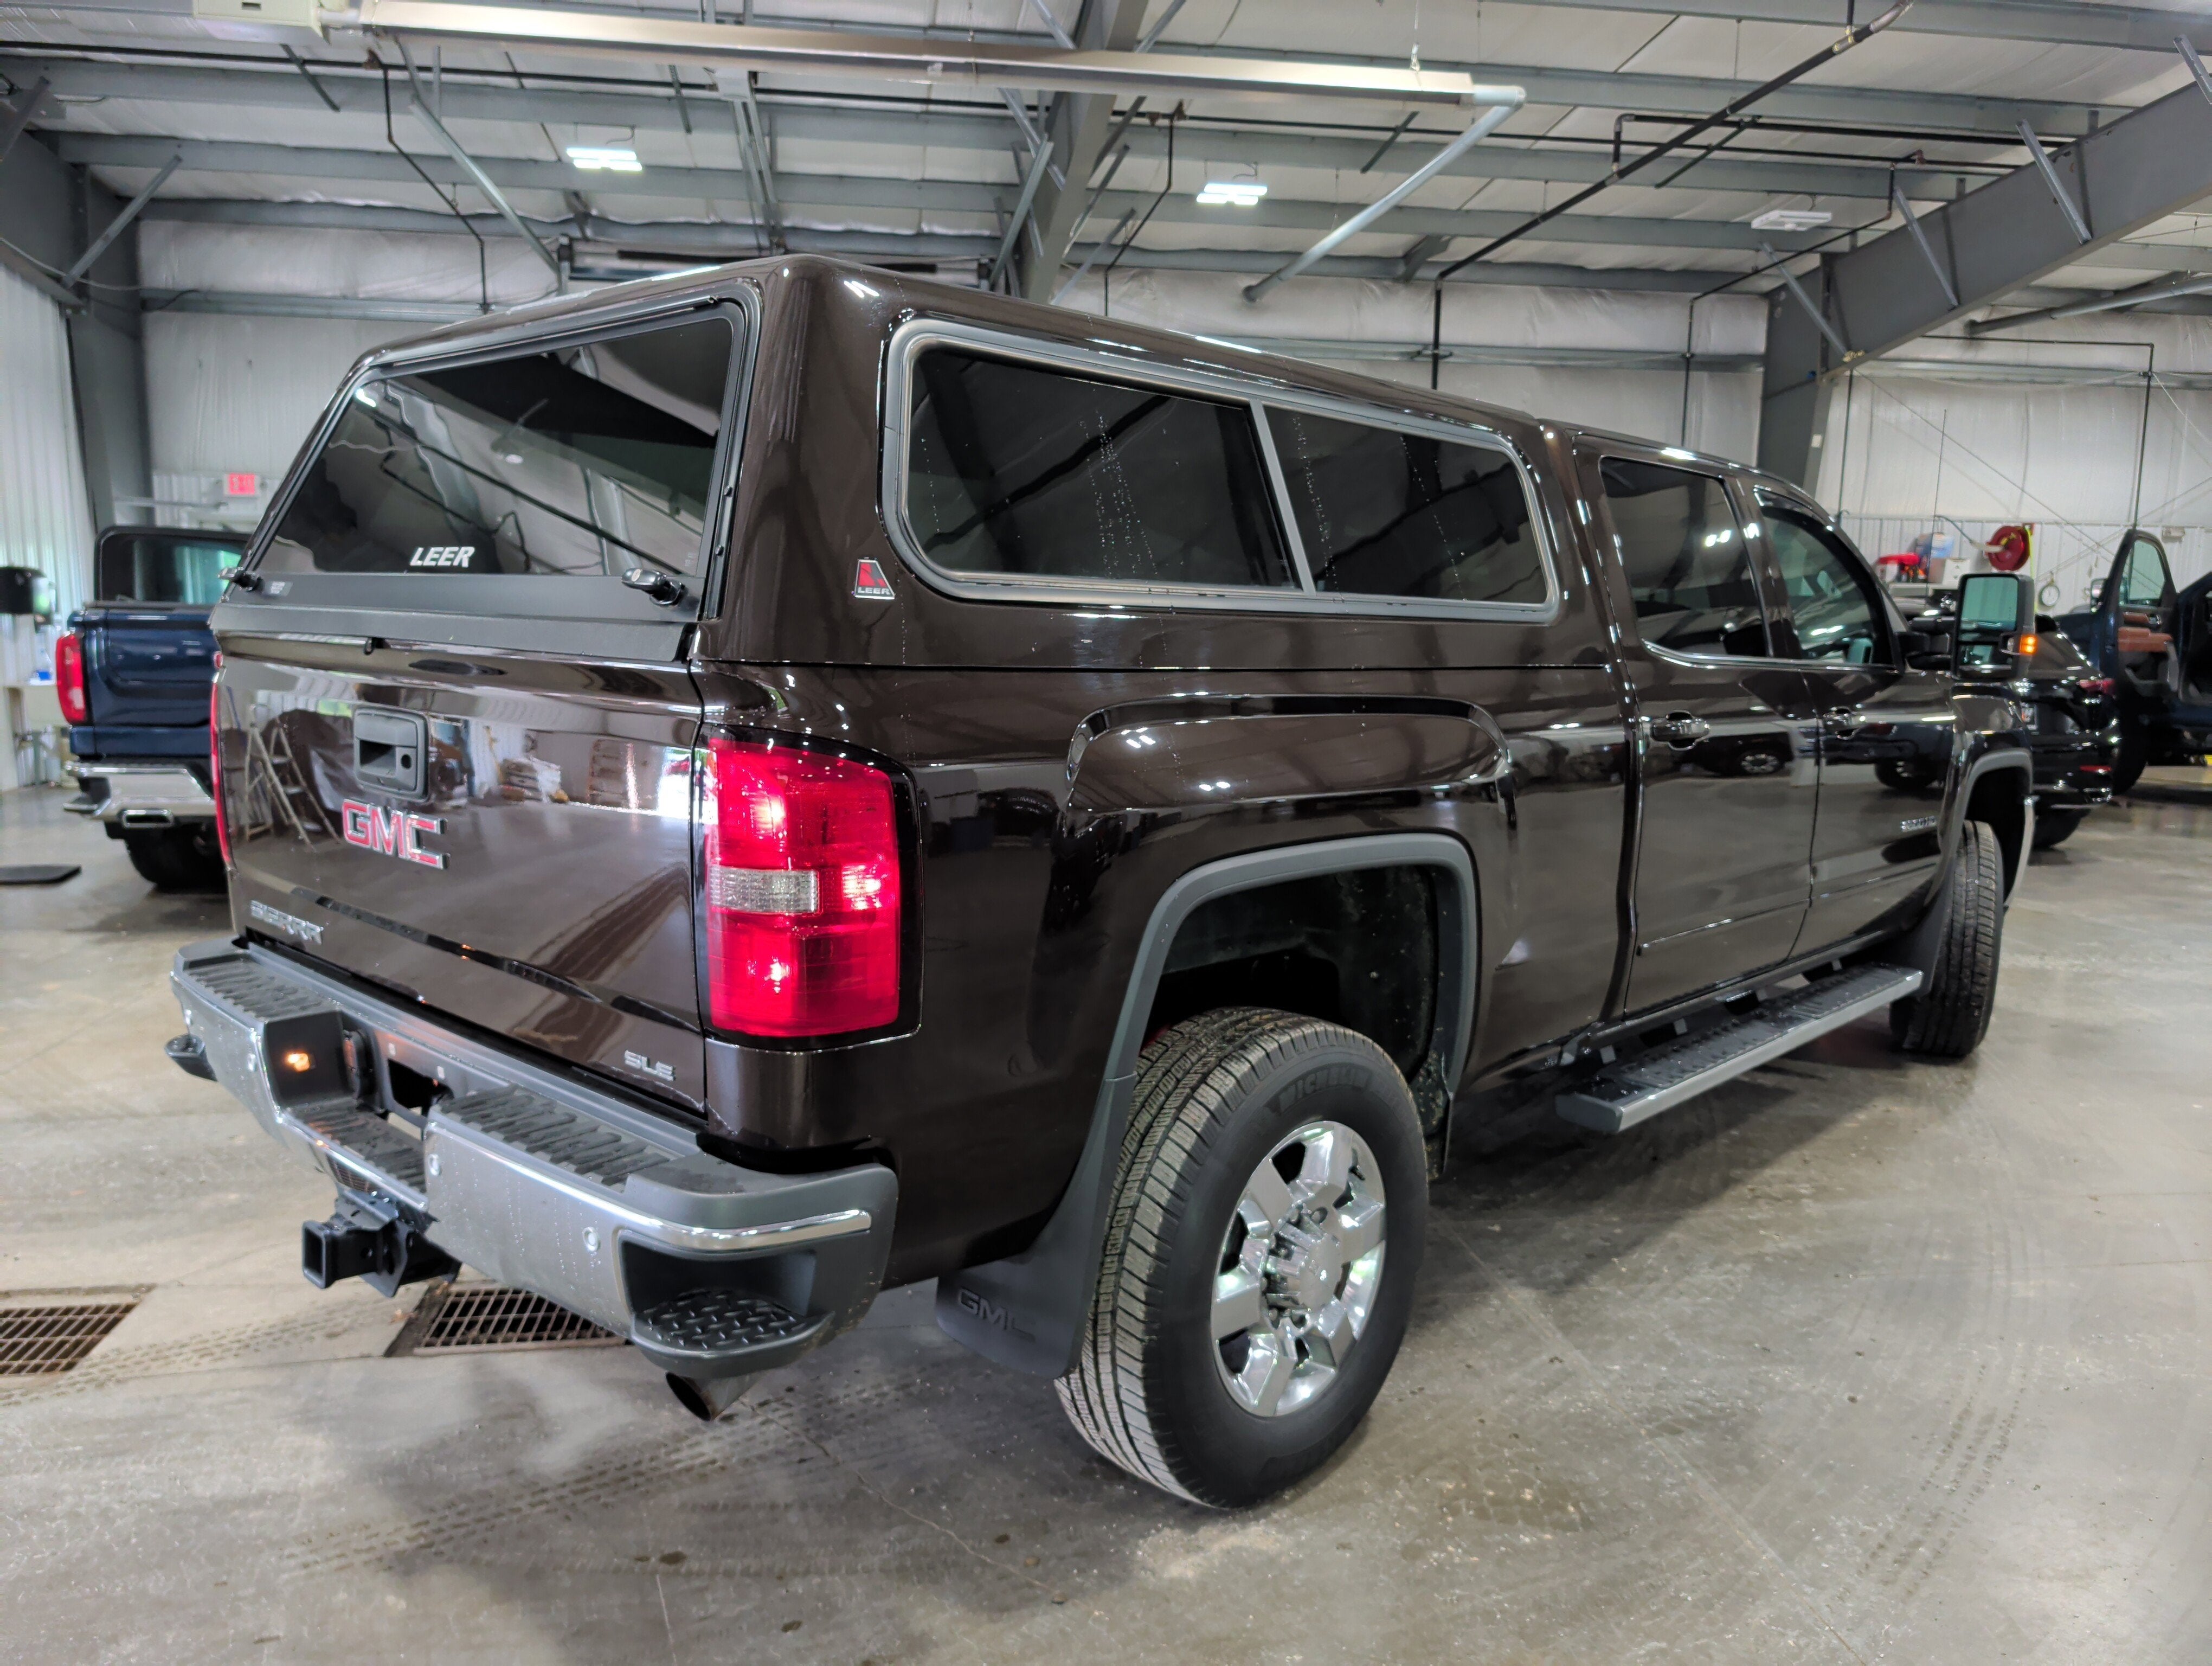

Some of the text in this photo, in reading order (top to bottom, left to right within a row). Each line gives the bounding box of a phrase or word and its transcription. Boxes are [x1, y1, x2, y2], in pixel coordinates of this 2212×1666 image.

[410, 546, 475, 568] LEER
[858, 587, 890, 595] LEER
[342, 798, 446, 870] GMC
[250, 900, 323, 945] SIERRA
[624, 1050, 675, 1081] SLE
[957, 1287, 1036, 1343] GMC
